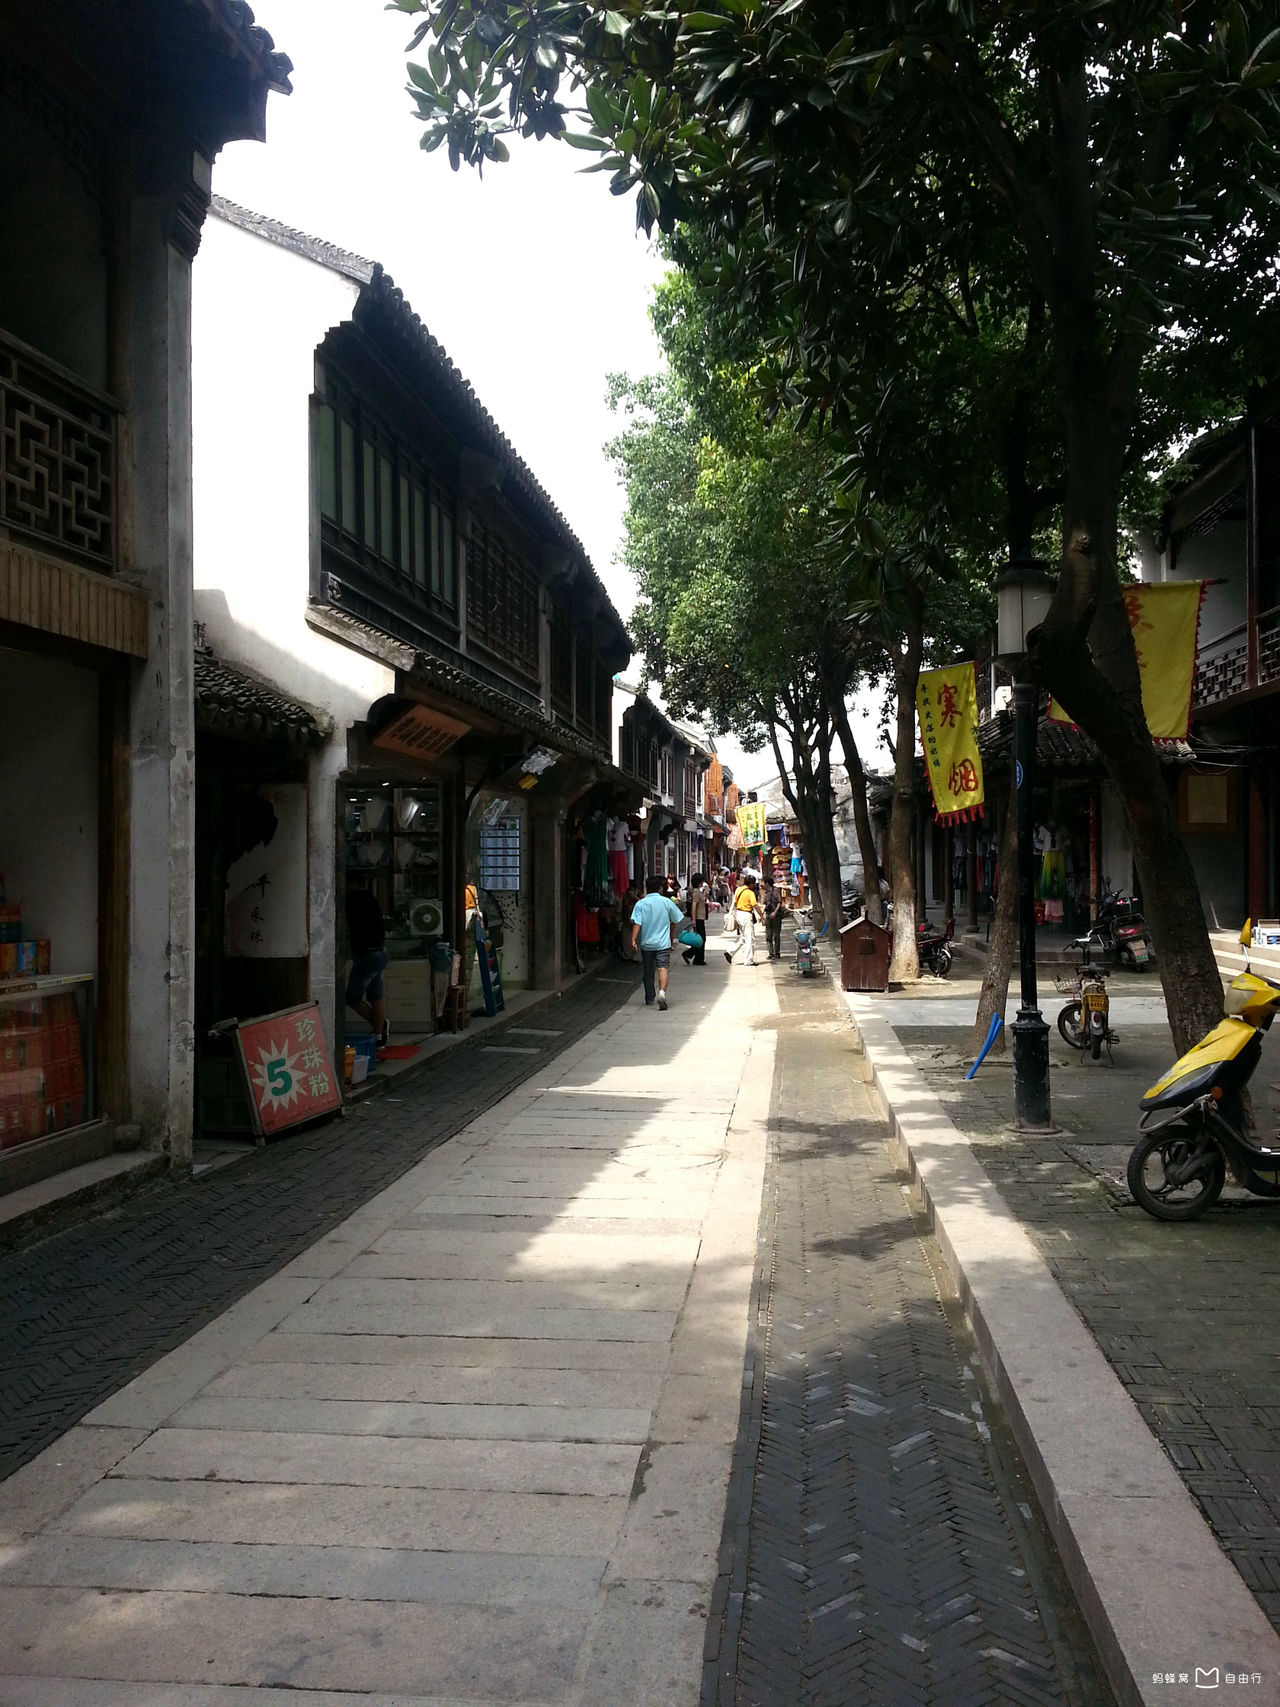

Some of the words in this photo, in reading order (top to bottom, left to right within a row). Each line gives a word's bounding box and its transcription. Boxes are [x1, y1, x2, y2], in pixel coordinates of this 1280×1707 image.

[267, 1057, 292, 1096] 5
[295, 1018, 330, 1097] 珍珠粉
